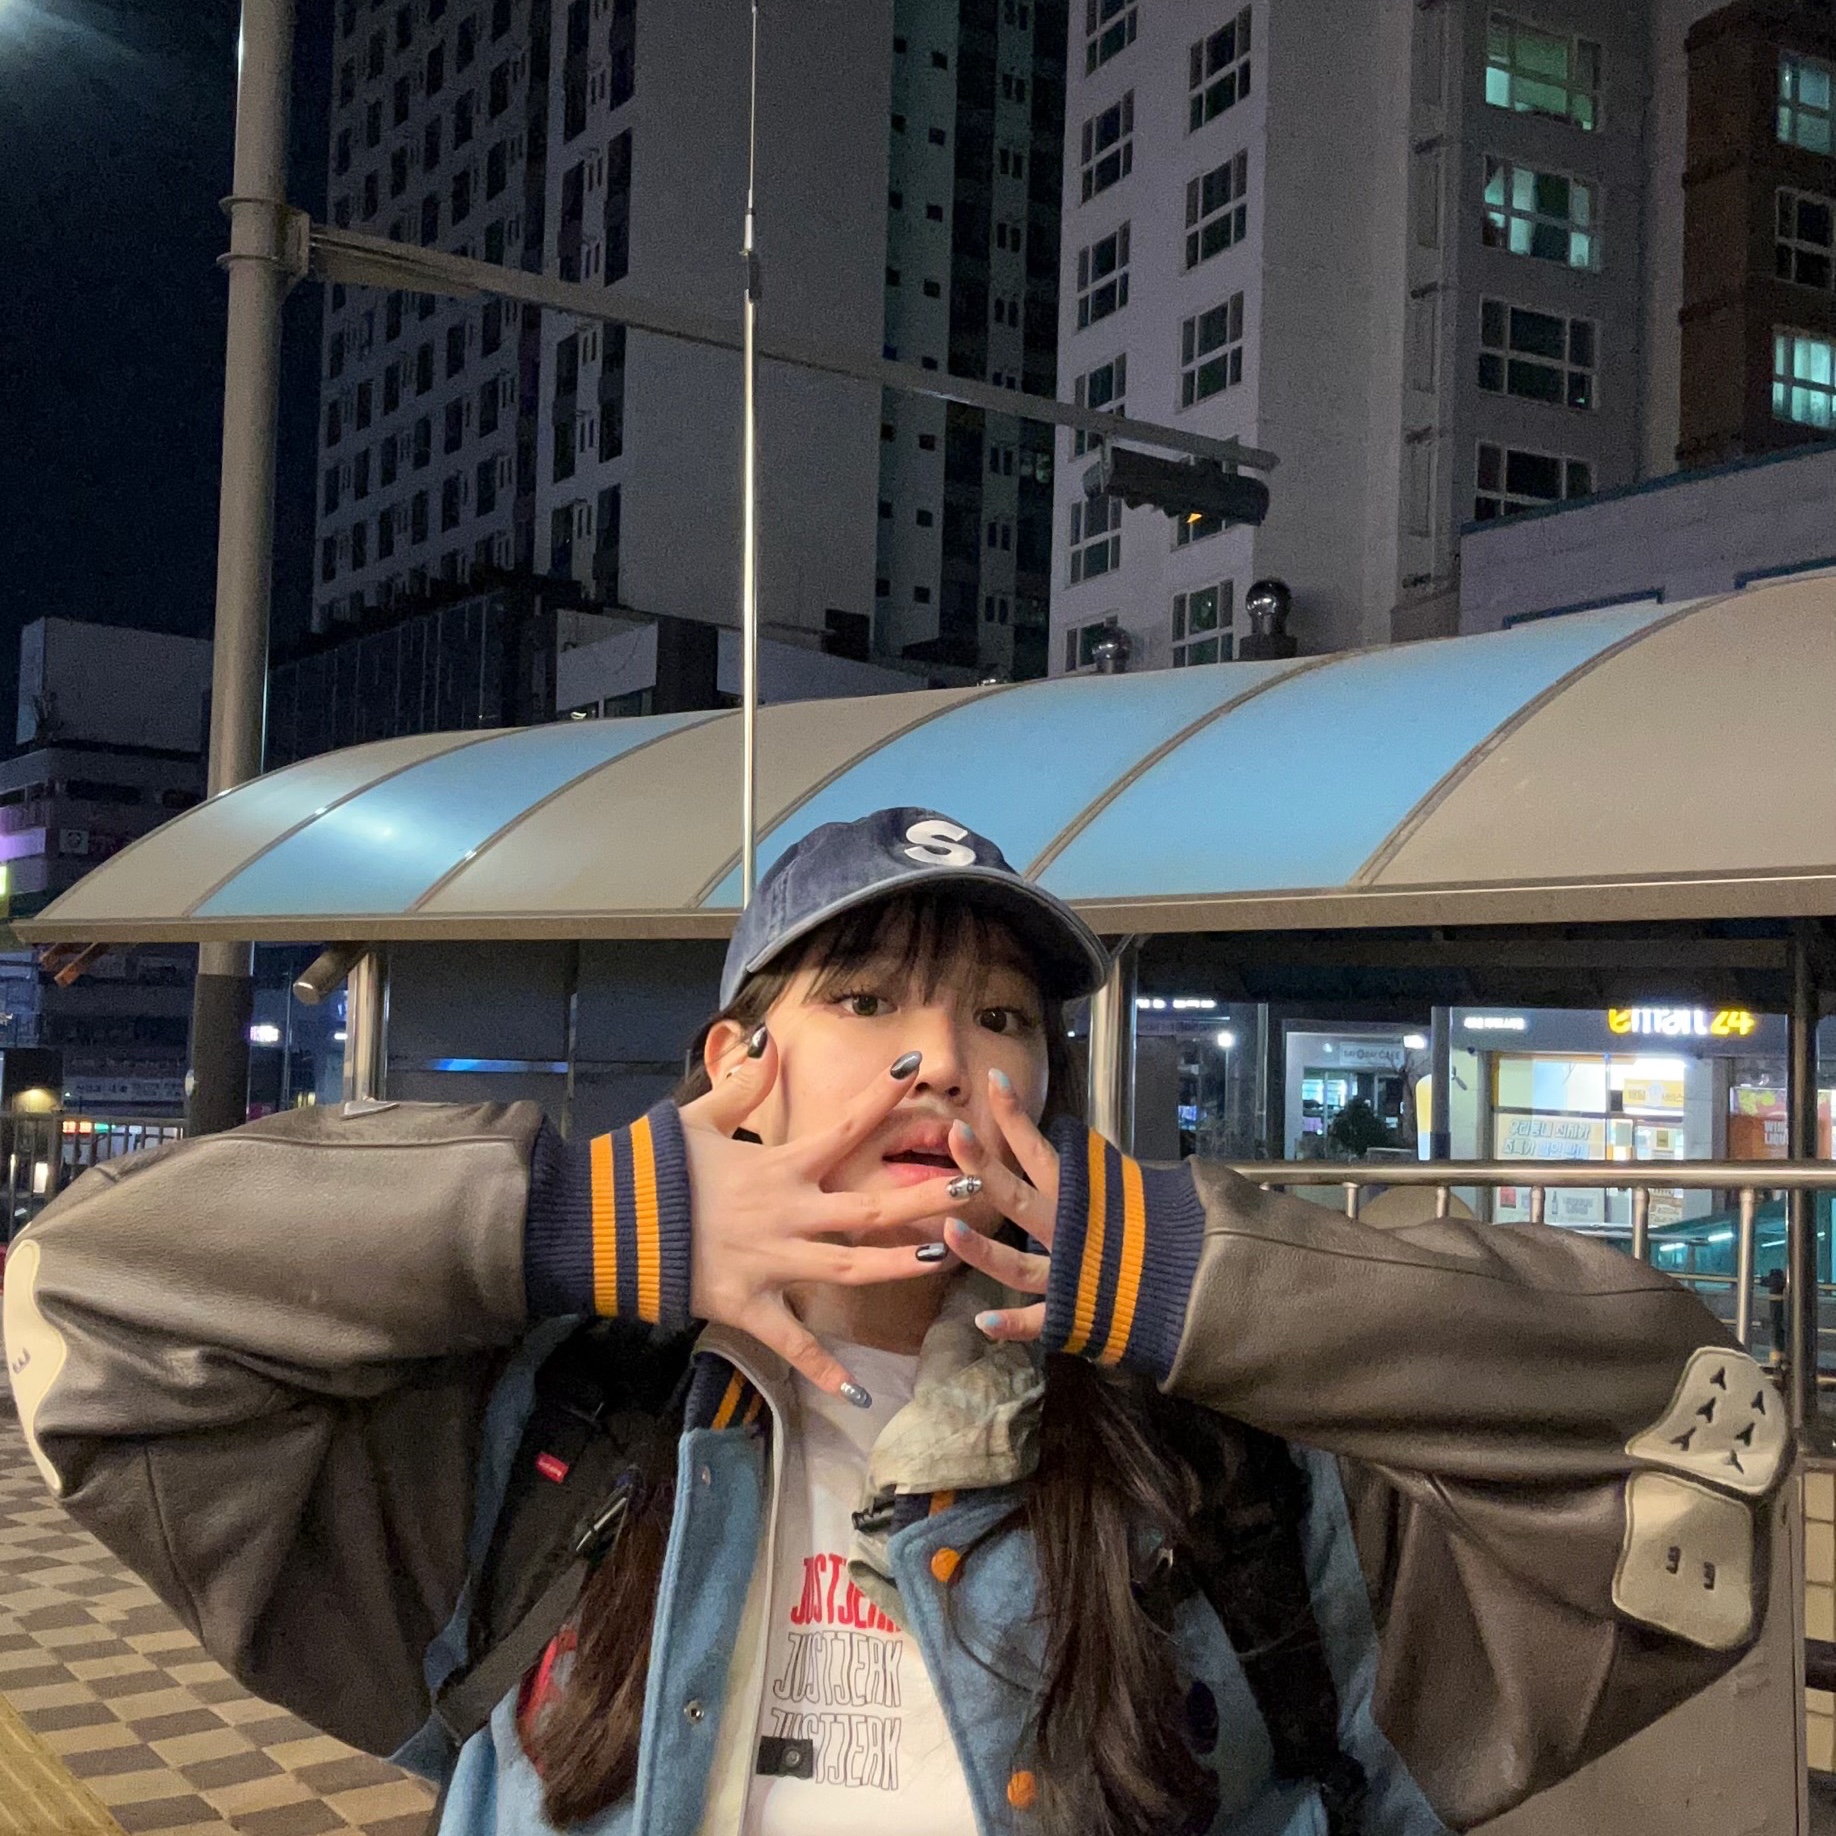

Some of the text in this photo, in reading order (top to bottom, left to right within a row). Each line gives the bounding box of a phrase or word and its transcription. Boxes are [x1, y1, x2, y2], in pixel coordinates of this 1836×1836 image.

[904, 819, 977, 867] S
[791, 1553, 902, 1632] JUSTJE
[773, 1630, 903, 1708] JUSTJERK
